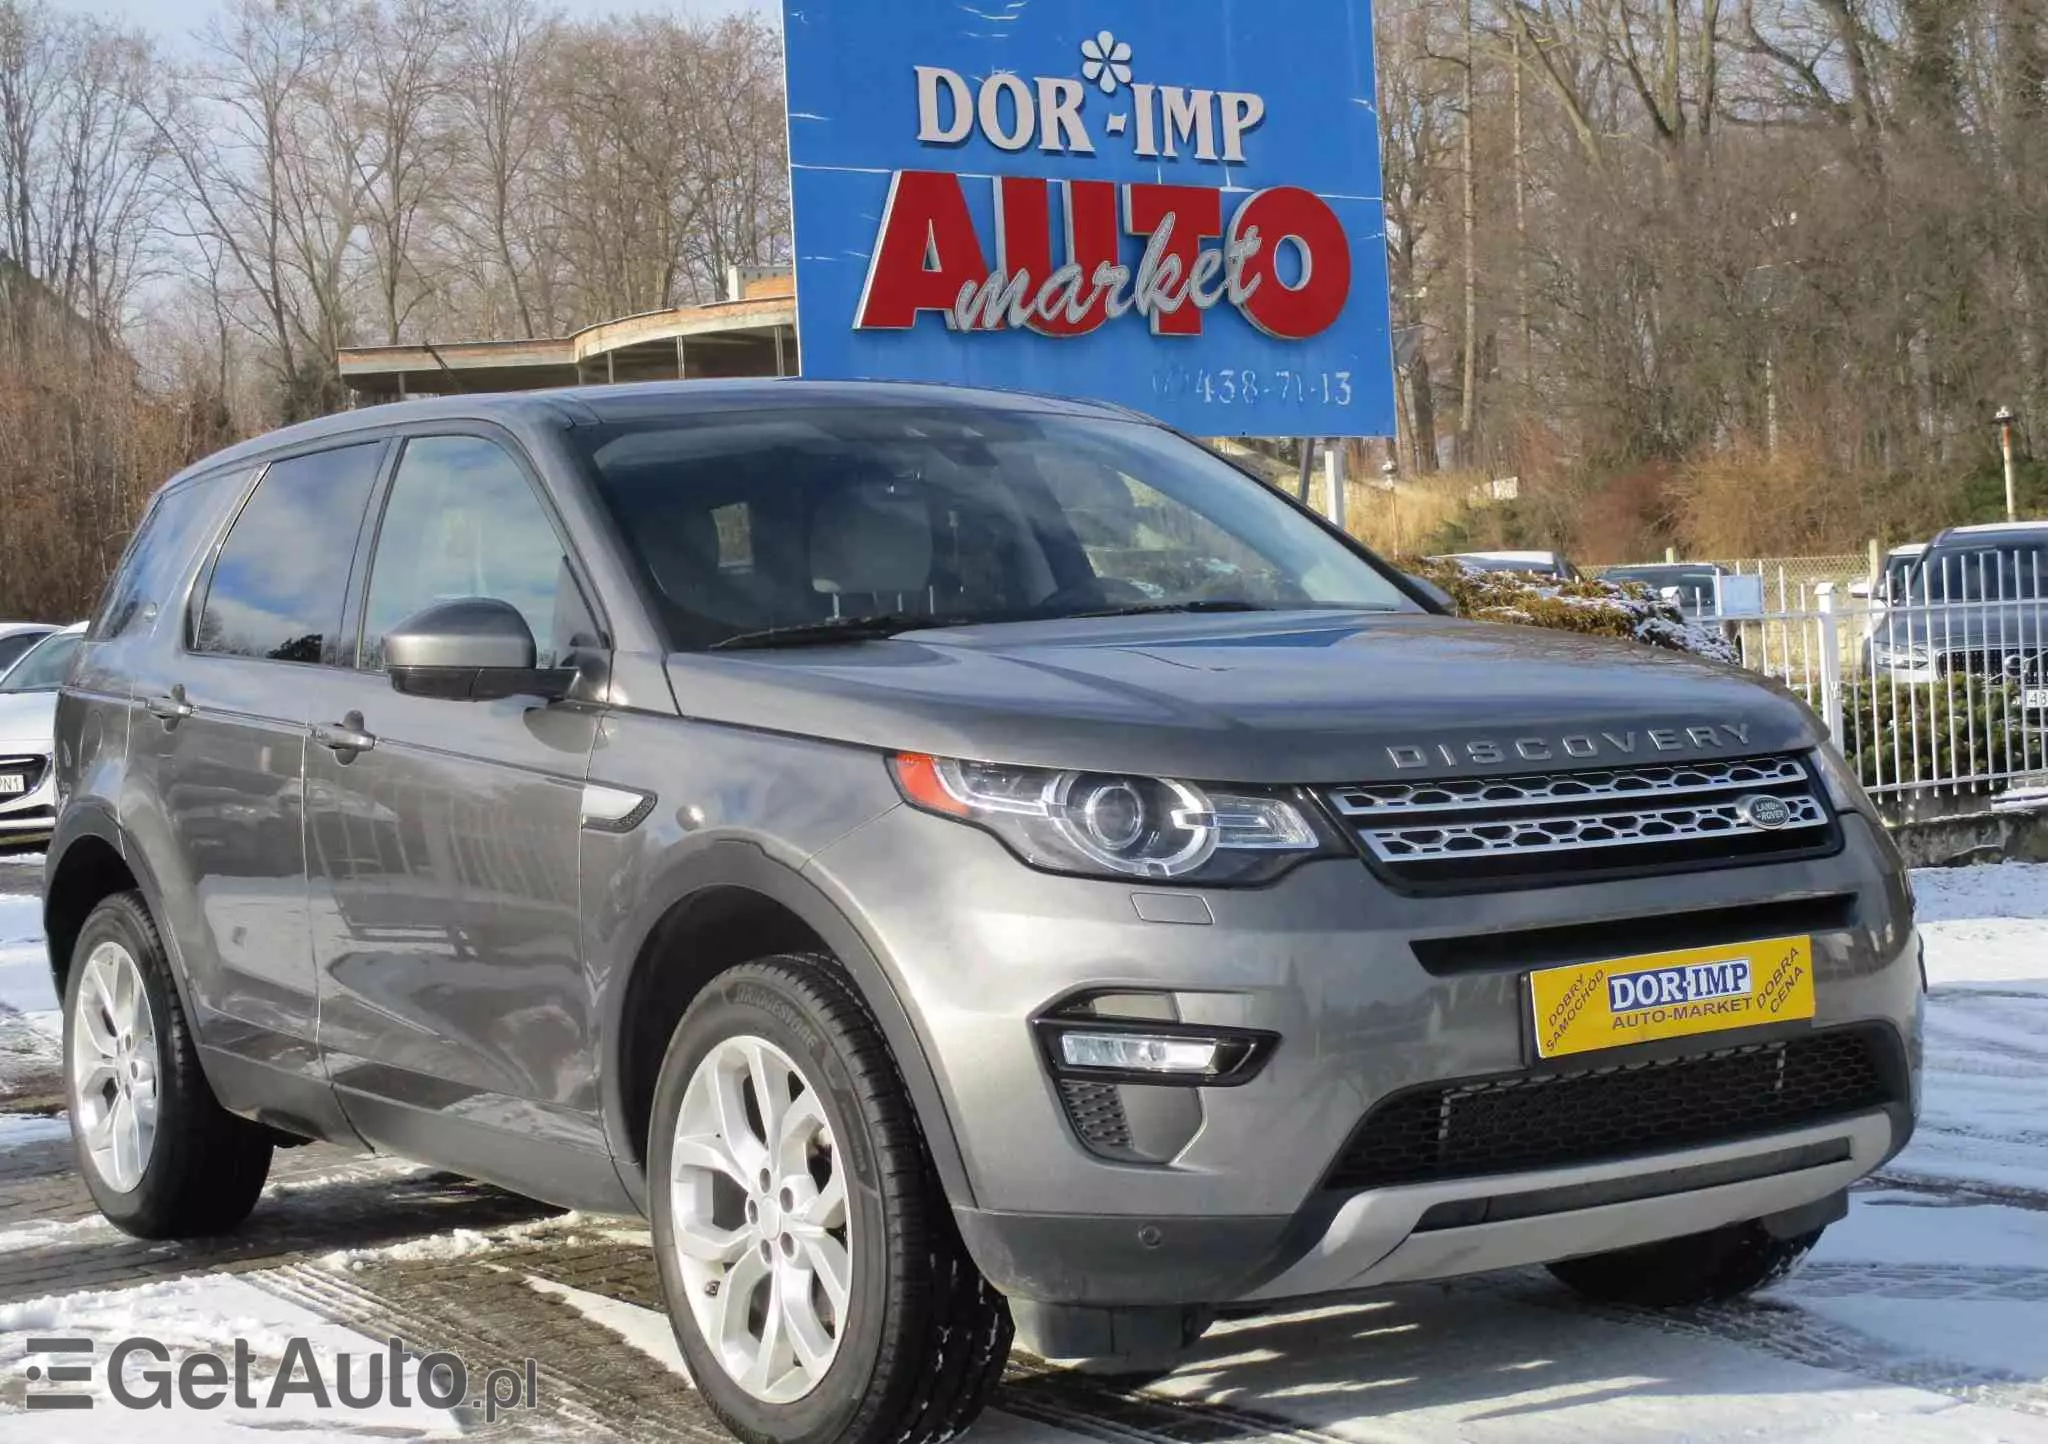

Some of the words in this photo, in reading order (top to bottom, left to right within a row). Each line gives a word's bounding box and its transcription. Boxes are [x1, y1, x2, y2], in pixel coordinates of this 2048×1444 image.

[914, 65, 1265, 162] DOR-IMP
[853, 170, 1351, 339] AUTO
[952, 211, 1263, 333] market
[1386, 722, 1752, 769] DISCOVERY
[1756, 800, 1777, 811] LAND
[1761, 809, 1784, 821] ROVER
[1549, 974, 1585, 1027] DOBRY
[1757, 947, 1799, 1009] DOBRA
[1771, 966, 1804, 1013] CENA
[1612, 997, 1752, 1030] AUTO-MARKET
